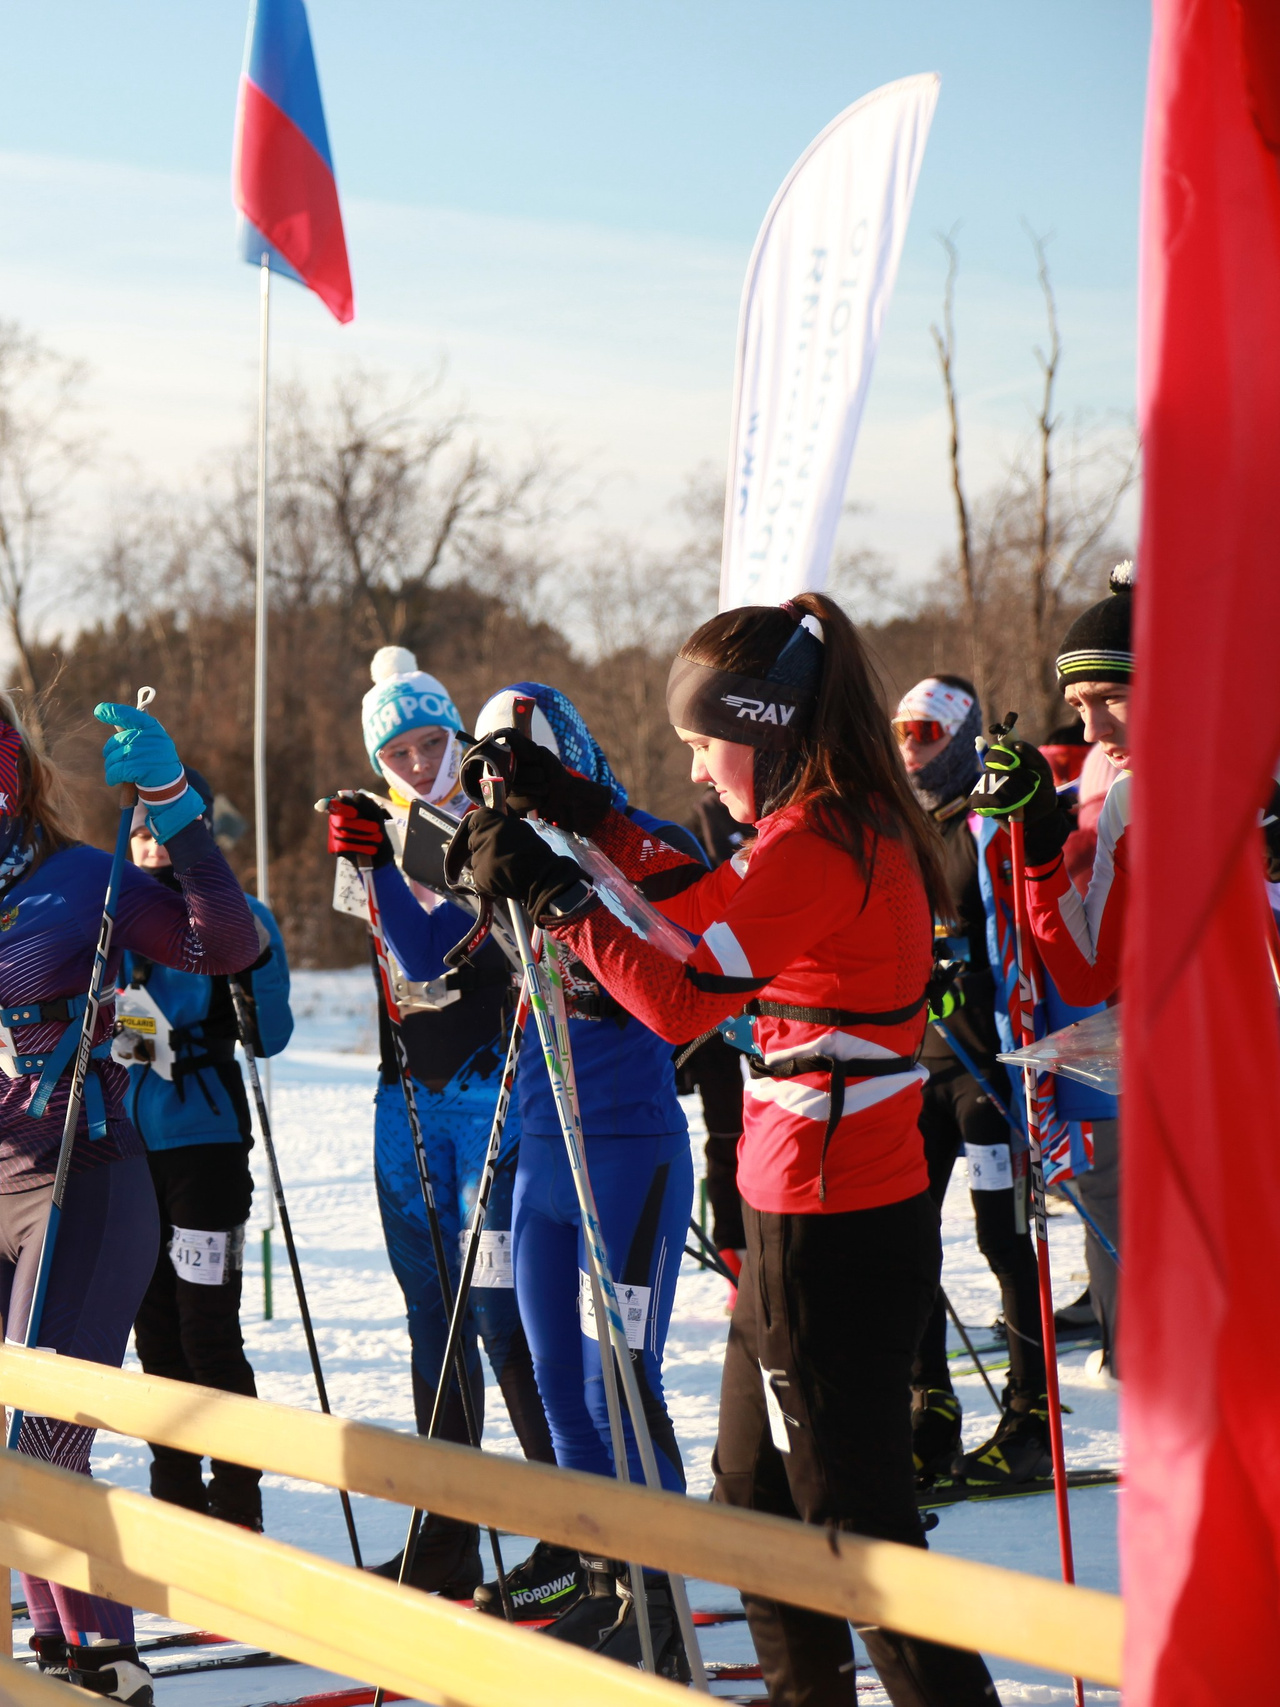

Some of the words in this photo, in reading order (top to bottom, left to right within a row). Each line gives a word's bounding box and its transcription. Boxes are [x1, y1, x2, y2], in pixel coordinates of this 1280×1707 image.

[721, 695, 796, 726] RAY
[970, 773, 1010, 796] AY
[73, 1038, 92, 1098] CYBER
[176, 1247, 202, 1267] 412
[512, 1571, 576, 1608] NORDWAY
